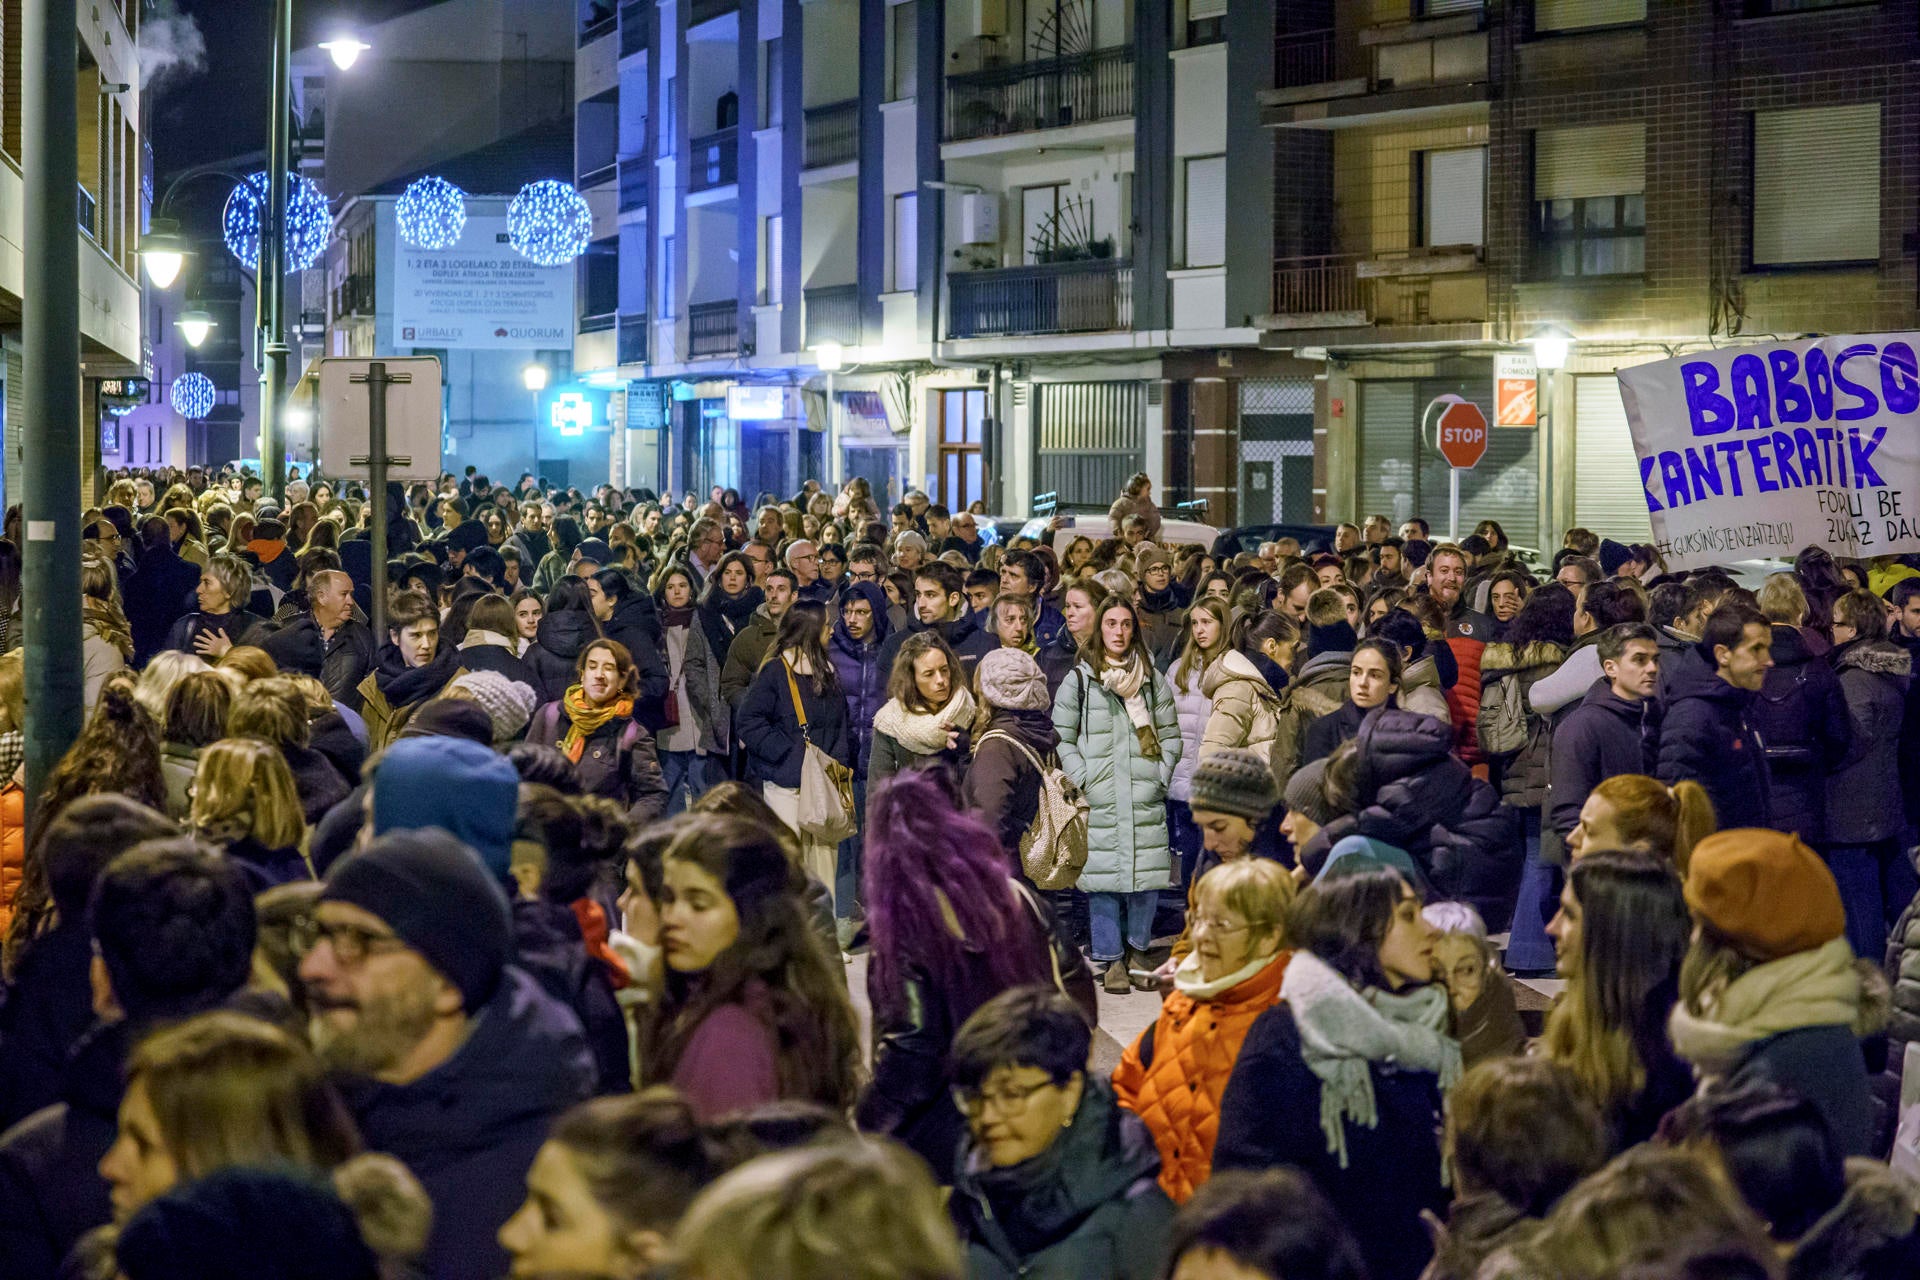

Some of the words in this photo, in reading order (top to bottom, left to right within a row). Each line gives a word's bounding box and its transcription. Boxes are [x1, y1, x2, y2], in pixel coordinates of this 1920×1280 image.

[424, 259, 439, 269] ETA
[449, 259, 498, 269] LOGELAKO
[500, 260, 511, 269] 20
[417, 328, 464, 338] URBALEX
[510, 328, 564, 339] QUORUM
[1501, 367, 1536, 376] COMIDAS
[1680, 342, 1920, 436] BABOSO
[1444, 427, 1483, 443] STOP
[1877, 490, 1902, 518] BE
